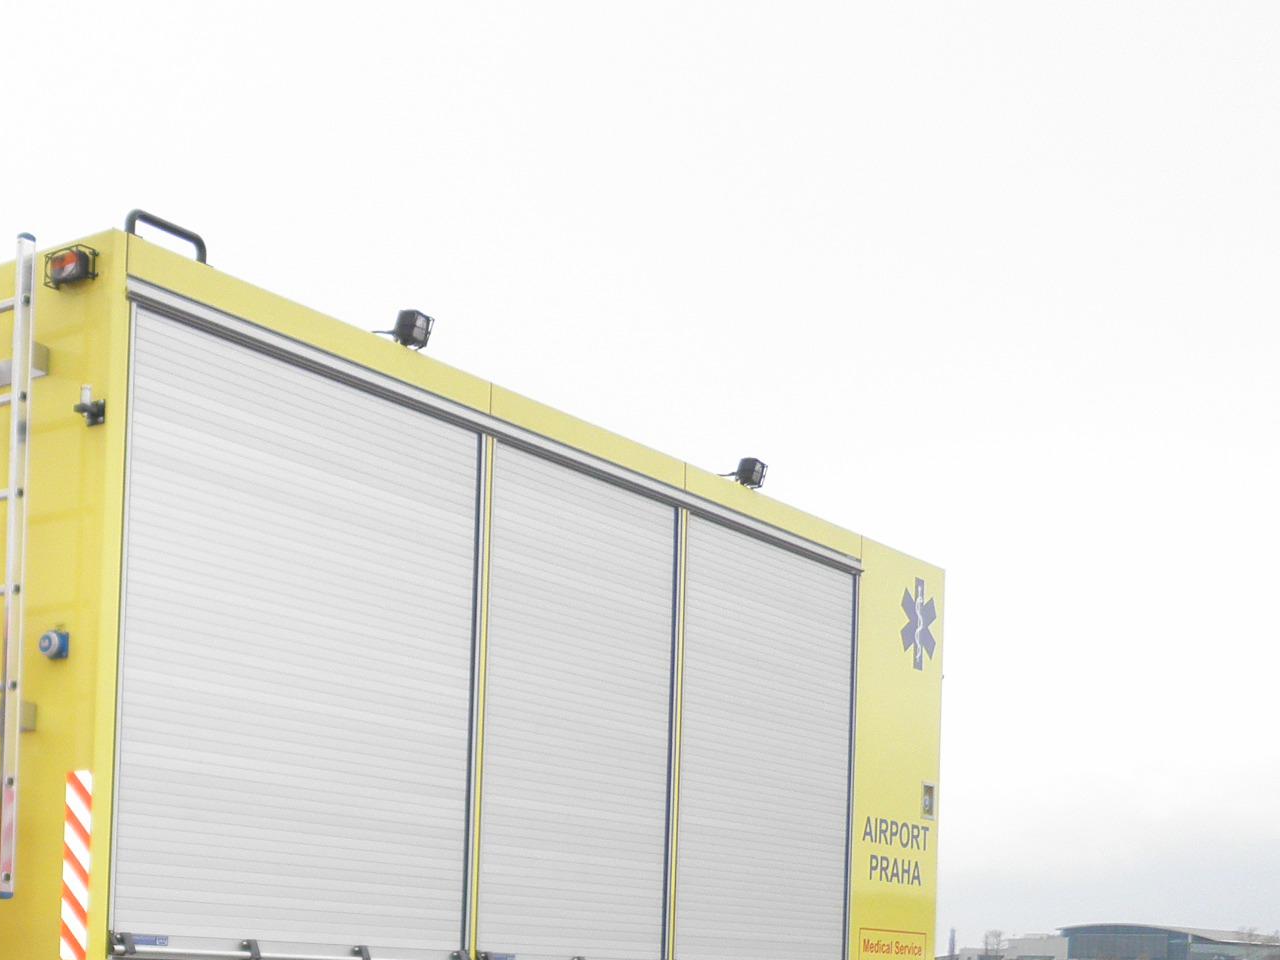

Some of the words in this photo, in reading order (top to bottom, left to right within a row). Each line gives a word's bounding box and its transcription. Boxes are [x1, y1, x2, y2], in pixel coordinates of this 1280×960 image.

[862, 816, 930, 851] AIRPORT
[869, 854, 922, 886] PRAHA
[863, 938, 893, 955] Medical
[895, 941, 922, 957] Service
